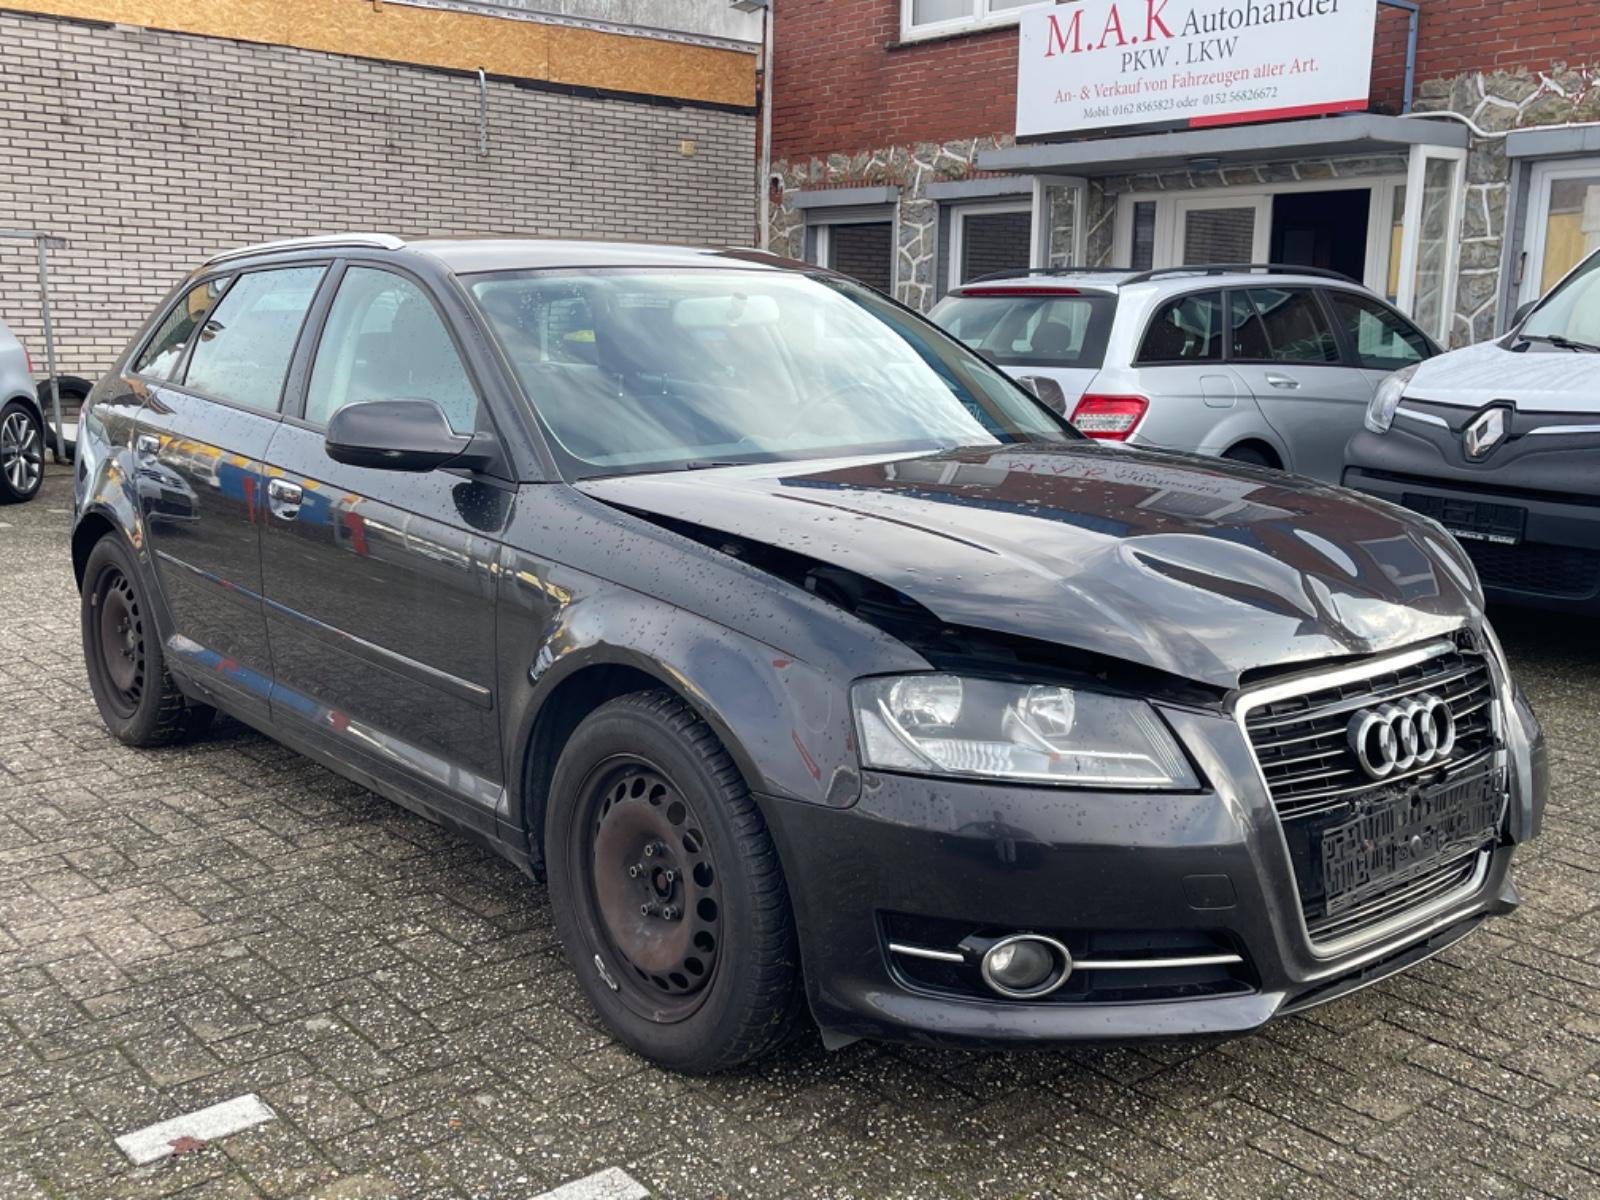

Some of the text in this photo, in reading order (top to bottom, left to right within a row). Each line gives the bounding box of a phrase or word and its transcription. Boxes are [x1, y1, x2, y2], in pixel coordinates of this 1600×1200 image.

[1044, 0, 1175, 57] M.A.K
[1120, 46, 1170, 73] PKW
[1185, 36, 1239, 64] LKW
[1054, 57, 1318, 104] An- & Verkauf von Fahrzeugen aller Art.
[1112, 103, 1134, 116] 0162
[1176, 96, 1199, 109] oder
[1203, 93, 1226, 105] 0152
